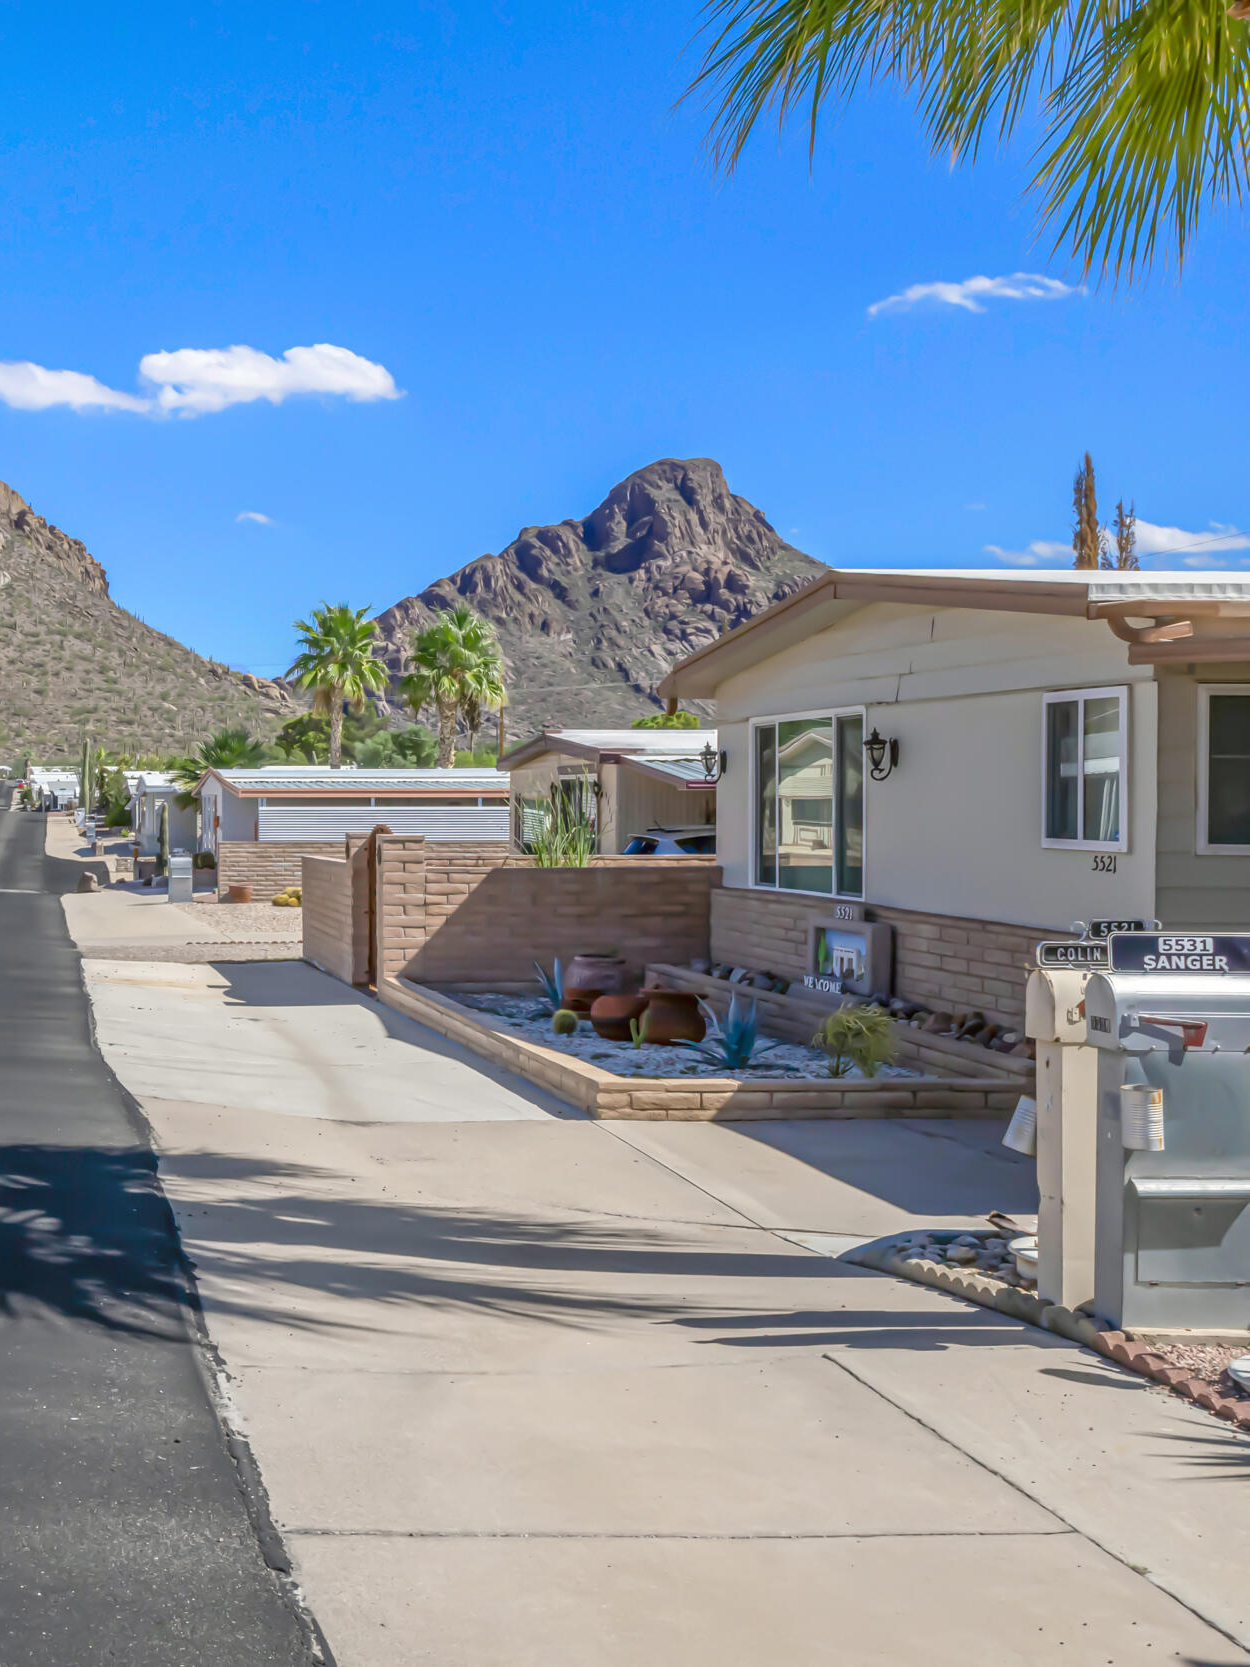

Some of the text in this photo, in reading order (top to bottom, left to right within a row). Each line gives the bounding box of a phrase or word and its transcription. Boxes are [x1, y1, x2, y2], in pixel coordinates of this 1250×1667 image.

[1091, 855, 1117, 874] 5521
[835, 906, 853, 920] 5521
[1162, 939, 1211, 952] 5531
[1057, 947, 1101, 961] COLIN
[1143, 955, 1229, 970] SANGER
